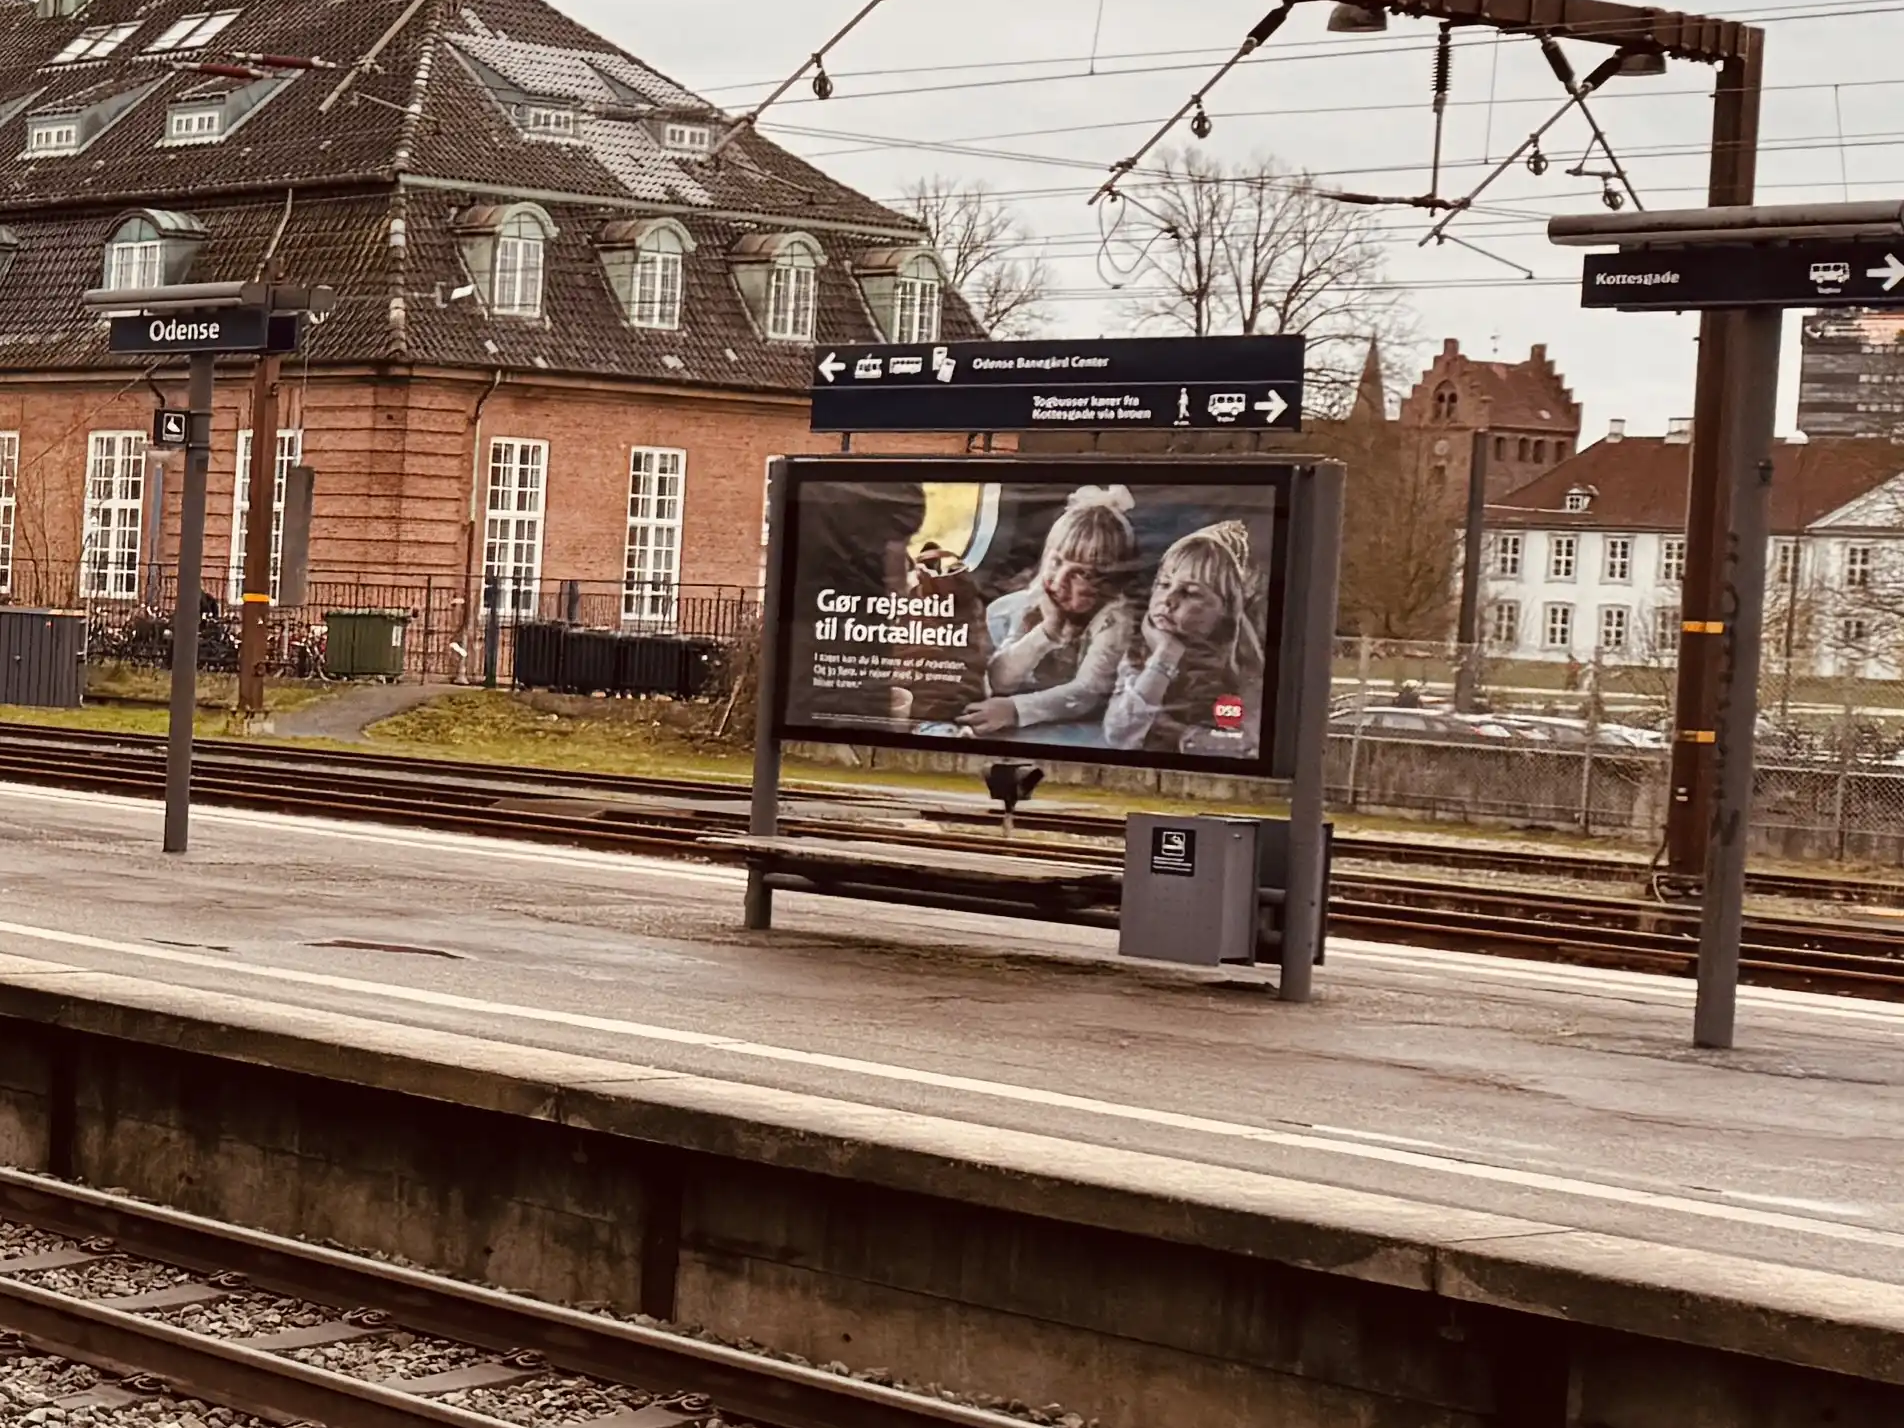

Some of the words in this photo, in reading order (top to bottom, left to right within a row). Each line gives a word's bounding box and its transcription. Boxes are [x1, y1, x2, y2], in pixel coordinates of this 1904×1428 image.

[149, 318, 220, 341] Odense
[817, 589, 861, 613] Gør
[866, 592, 955, 619] rejsetid
[815, 617, 837, 641] til
[844, 618, 969, 647] fortælletid
[1215, 704, 1242, 717] DSB
